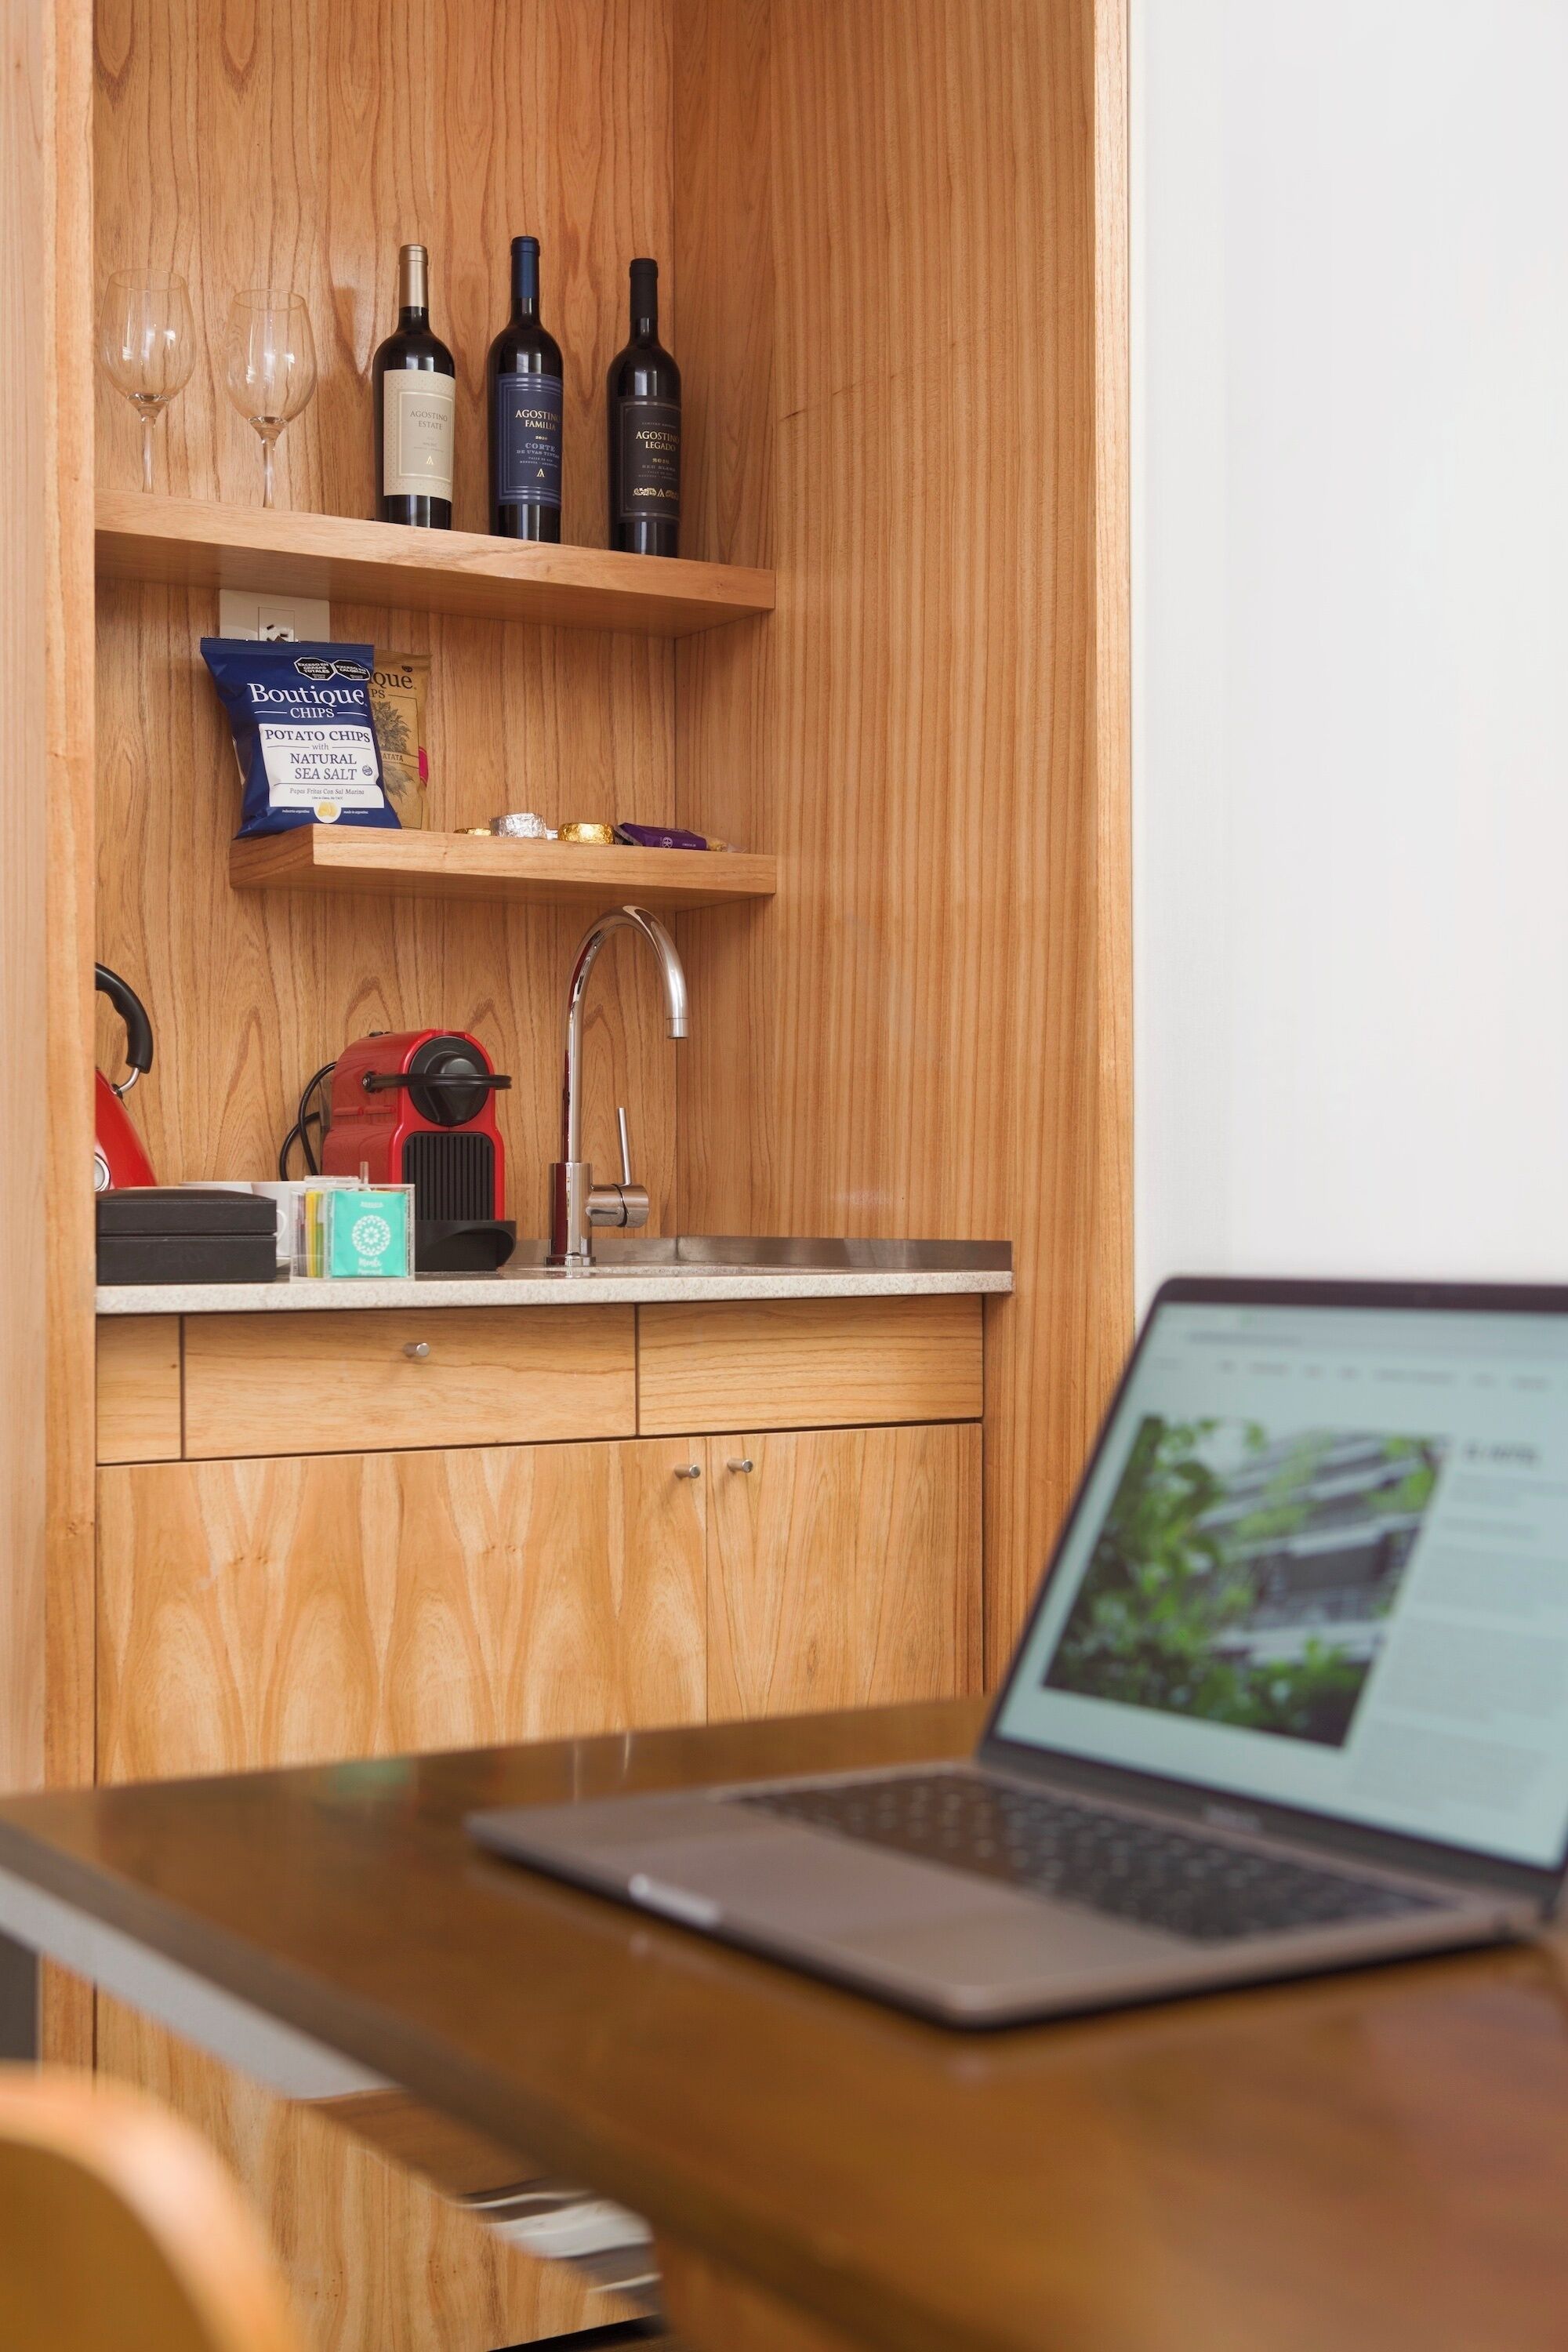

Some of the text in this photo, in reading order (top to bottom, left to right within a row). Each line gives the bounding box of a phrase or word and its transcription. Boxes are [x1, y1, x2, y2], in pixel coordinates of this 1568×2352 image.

[410, 410, 448, 422] AGOSTINO
[418, 420, 444, 430] ESTATE
[525, 419, 556, 430] FAMILIA
[524, 442, 555, 452] CORTE
[645, 441, 676, 452] LEGADO
[247, 683, 365, 707] Boutique
[290, 707, 336, 719] CHIPS
[264, 729, 370, 742] POTATO CHIPS
[290, 753, 357, 765] NATURAL
[295, 768, 321, 780] SEA
[324, 768, 358, 781] SALT
